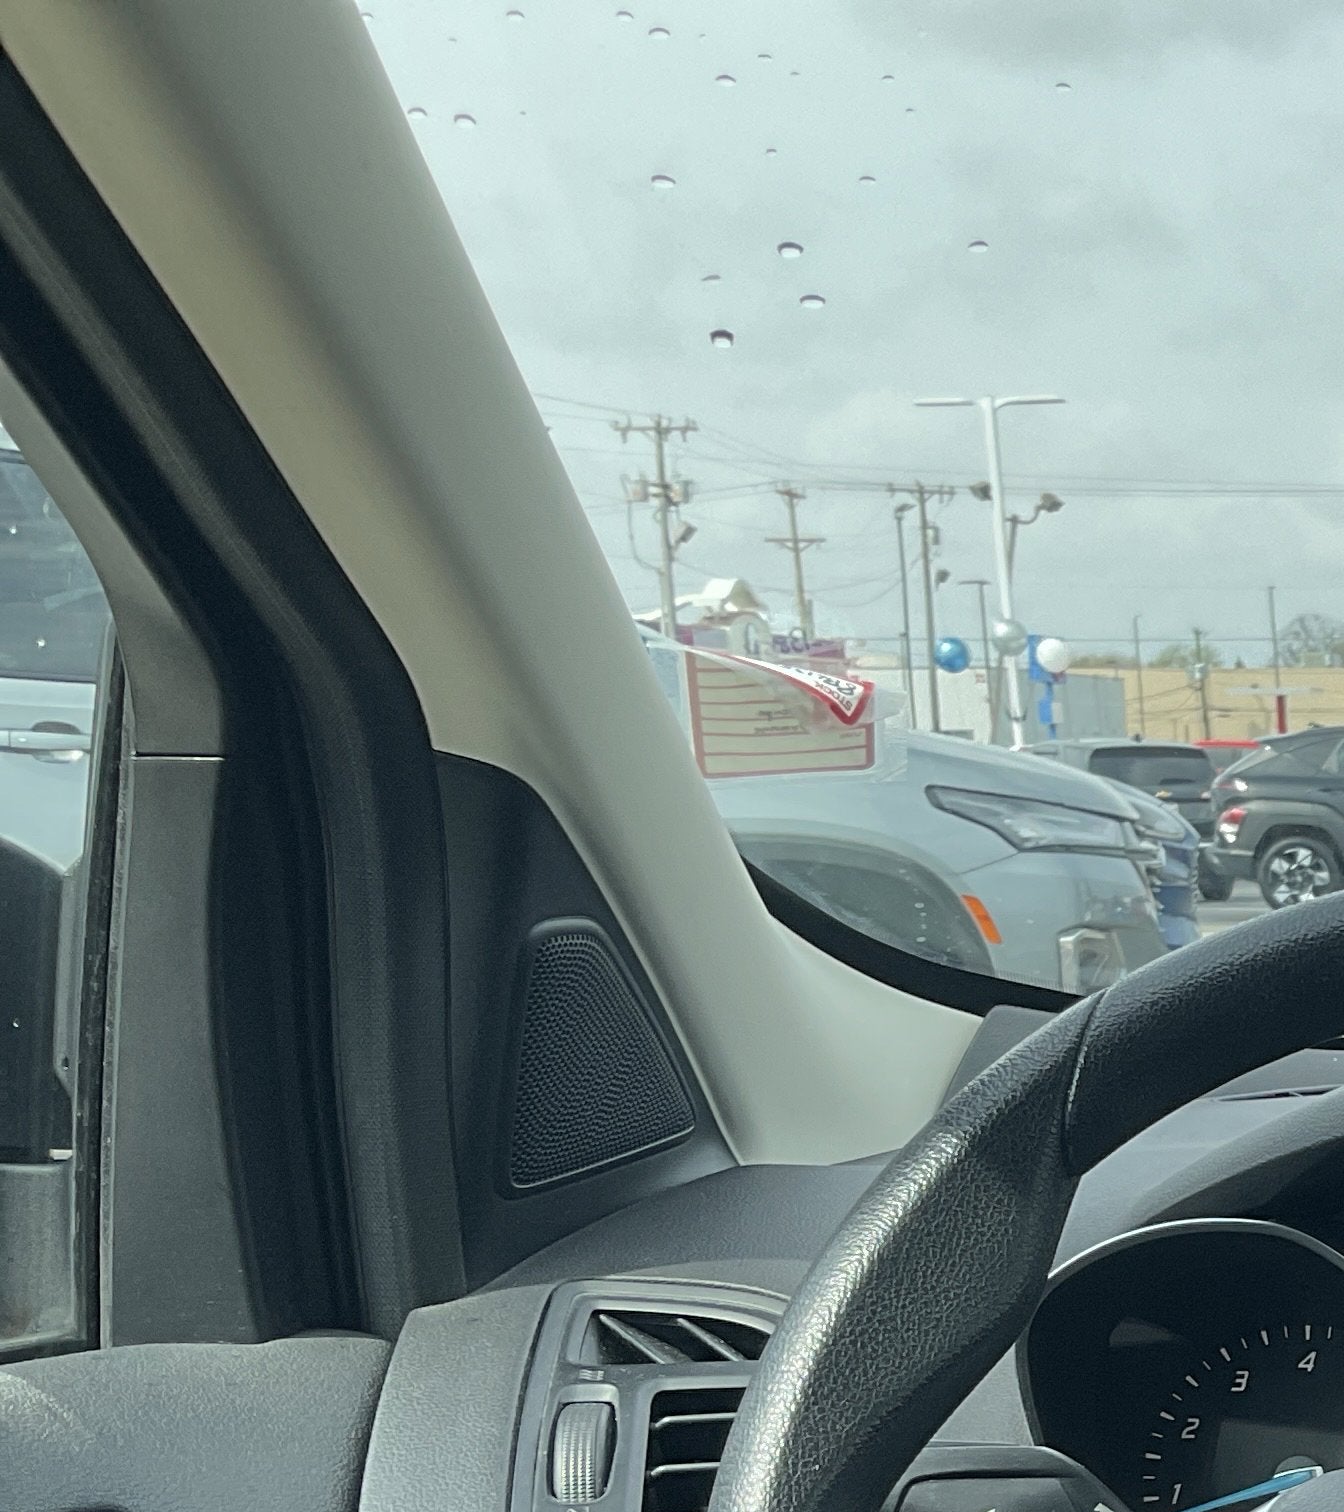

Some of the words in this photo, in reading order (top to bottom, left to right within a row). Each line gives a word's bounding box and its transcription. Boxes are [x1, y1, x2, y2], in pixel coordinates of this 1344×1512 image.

[1298, 1351, 1318, 1373] 4
[1231, 1370, 1250, 1392] 3
[1181, 1418, 1200, 1439] 2
[1171, 1483, 1183, 1505] 1
